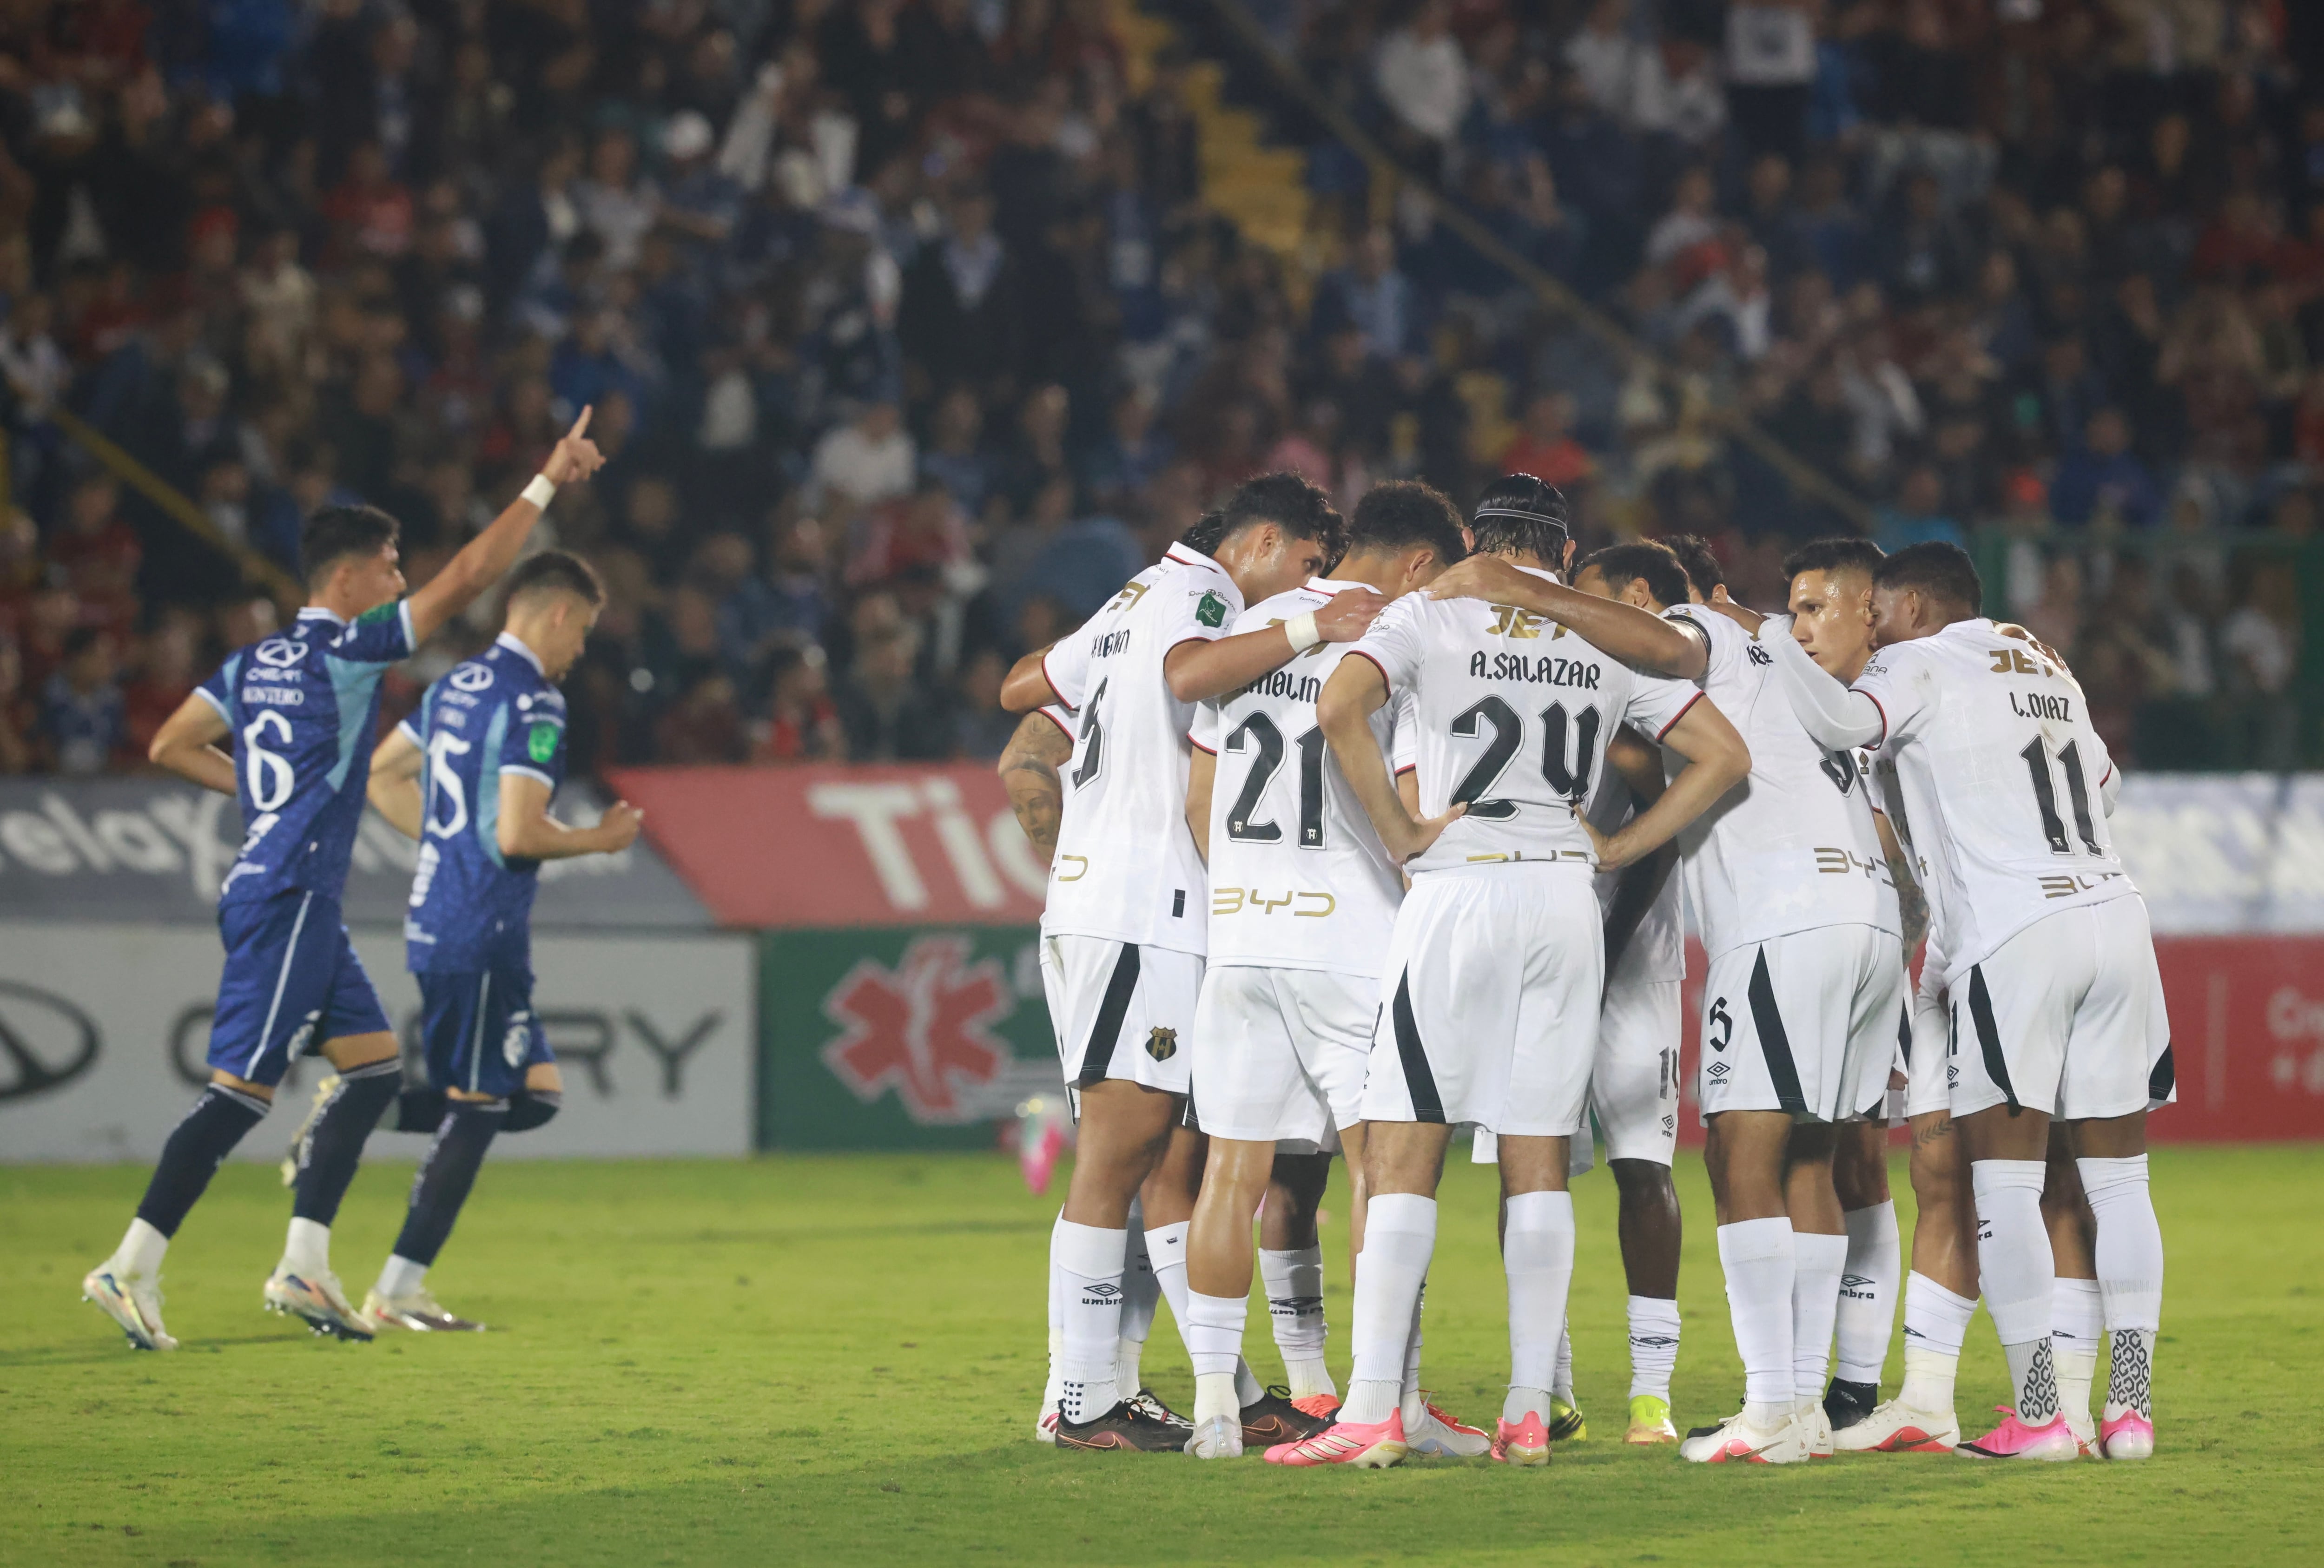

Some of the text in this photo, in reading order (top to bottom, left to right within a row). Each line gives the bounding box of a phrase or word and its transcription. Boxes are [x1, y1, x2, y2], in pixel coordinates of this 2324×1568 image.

[1470, 650, 1601, 691] A.SALAZAR
[2009, 691, 2073, 722] L.DIAZ
[244, 710, 295, 812] 6
[425, 730, 470, 839] 5
[1224, 710, 1327, 850] 21
[1449, 694, 1603, 822] 24
[2019, 733, 2106, 859] 11
[1212, 888, 1335, 917] BYD
[170, 1001, 723, 1101] CRY
[1710, 997, 1732, 1052] 5
